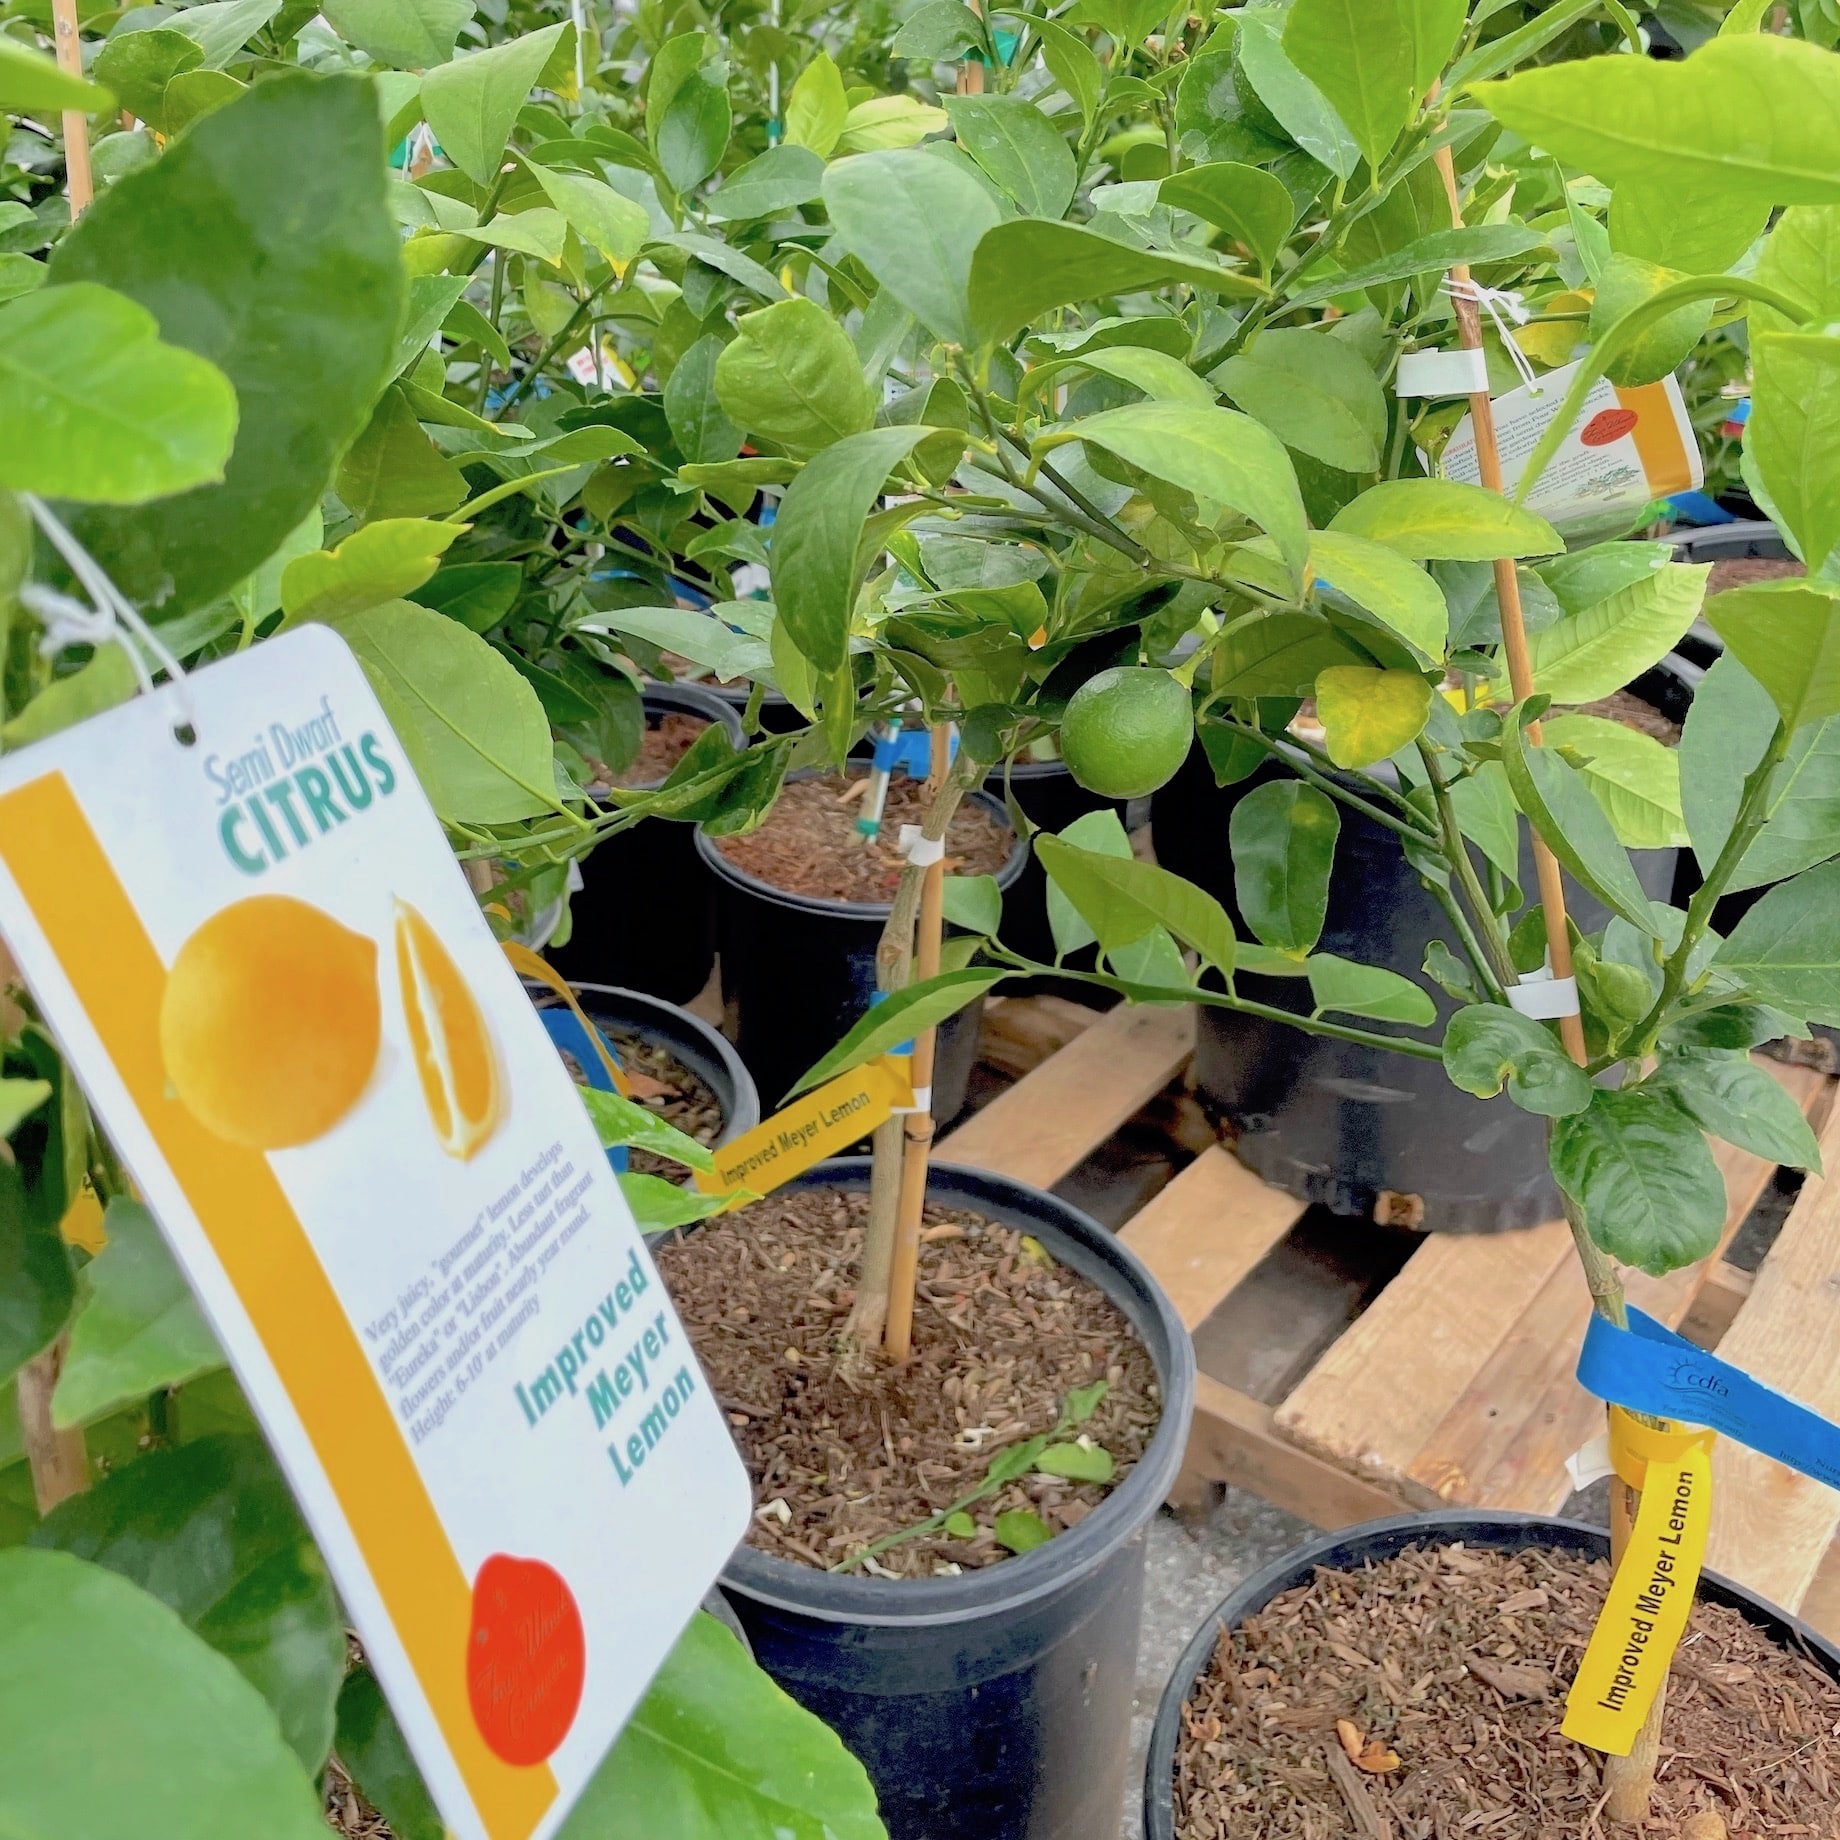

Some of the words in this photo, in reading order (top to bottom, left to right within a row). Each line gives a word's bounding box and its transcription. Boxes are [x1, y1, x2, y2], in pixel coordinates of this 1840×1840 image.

[203, 733, 276, 805] Semi
[268, 694, 342, 769] Dwarf
[218, 730, 397, 876] CITRUS
[719, 1142, 778, 1187] Improved
[778, 1119, 820, 1153] Meyer
[818, 1090, 871, 1128] Lemon
[364, 1311, 399, 1343] Very
[486, 1182, 522, 1224] lemon
[520, 1139, 564, 1191] develops
[378, 1322, 422, 1374] golden
[420, 1290, 450, 1327] color
[506, 1202, 535, 1234] Less
[550, 1160, 575, 1190] than
[442, 1315, 459, 1338] or
[506, 1211, 558, 1267] Abundant
[554, 1171, 594, 1220] fragrant
[399, 1367, 447, 1422] flowers
[446, 1328, 482, 1372] and/or
[480, 1296, 507, 1333] fruit
[505, 1260, 539, 1301] nearly
[536, 1239, 562, 1276] year
[498, 1292, 543, 1349] maturity
[514, 1247, 649, 1429] Improved
[585, 1310, 670, 1432] Meyer
[1687, 1375, 1730, 1397] cdfa
[607, 1363, 696, 1489] Lemon
[1597, 1616, 1654, 1713] Improved
[1635, 1551, 1677, 1614] Meyer
[1658, 1470, 1694, 1546] Lemon
